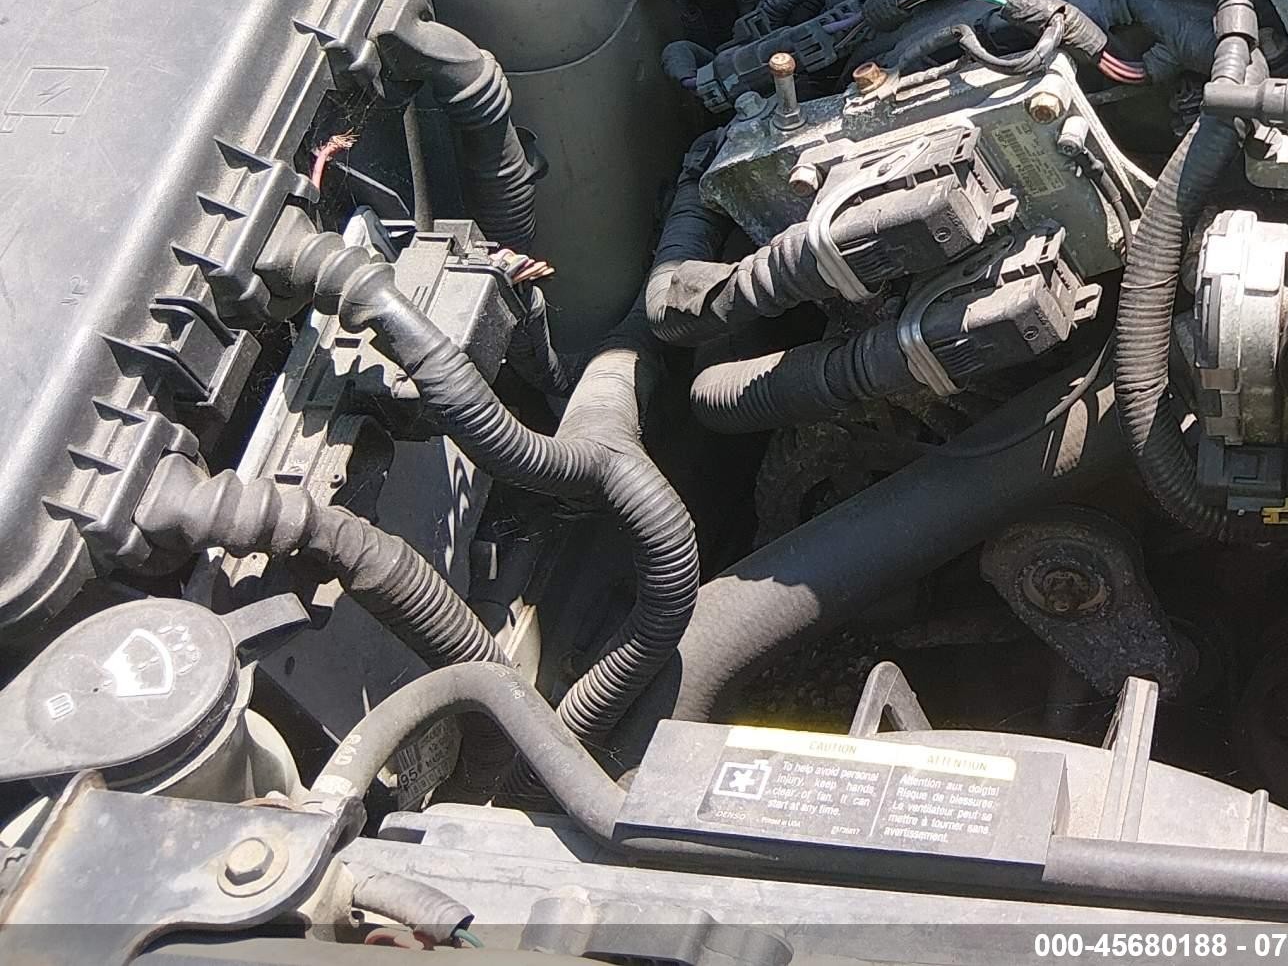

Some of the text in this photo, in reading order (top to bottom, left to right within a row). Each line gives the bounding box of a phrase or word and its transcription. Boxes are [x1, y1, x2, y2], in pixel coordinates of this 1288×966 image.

[808, 740, 857, 755] CAUTION
[782, 761, 879, 781] To help avoid personal
[927, 754, 988, 772] ATTENTION
[400, 768, 419, 787] 95
[814, 778, 837, 790] keep
[900, 774, 941, 789] Attention
[945, 782, 963, 792] aux
[800, 790, 811, 802] of
[853, 797, 871, 807] can
[896, 787, 928, 801] Risque
[932, 791, 944, 803] de
[715, 810, 746, 820] DENSO
[767, 799, 841, 816] start at any time.
[892, 800, 993, 822] Le ventilateur peut se
[888, 813, 919, 826] mettre
[931, 819, 965, 832] tourner
[883, 827, 950, 843] avertissement.
